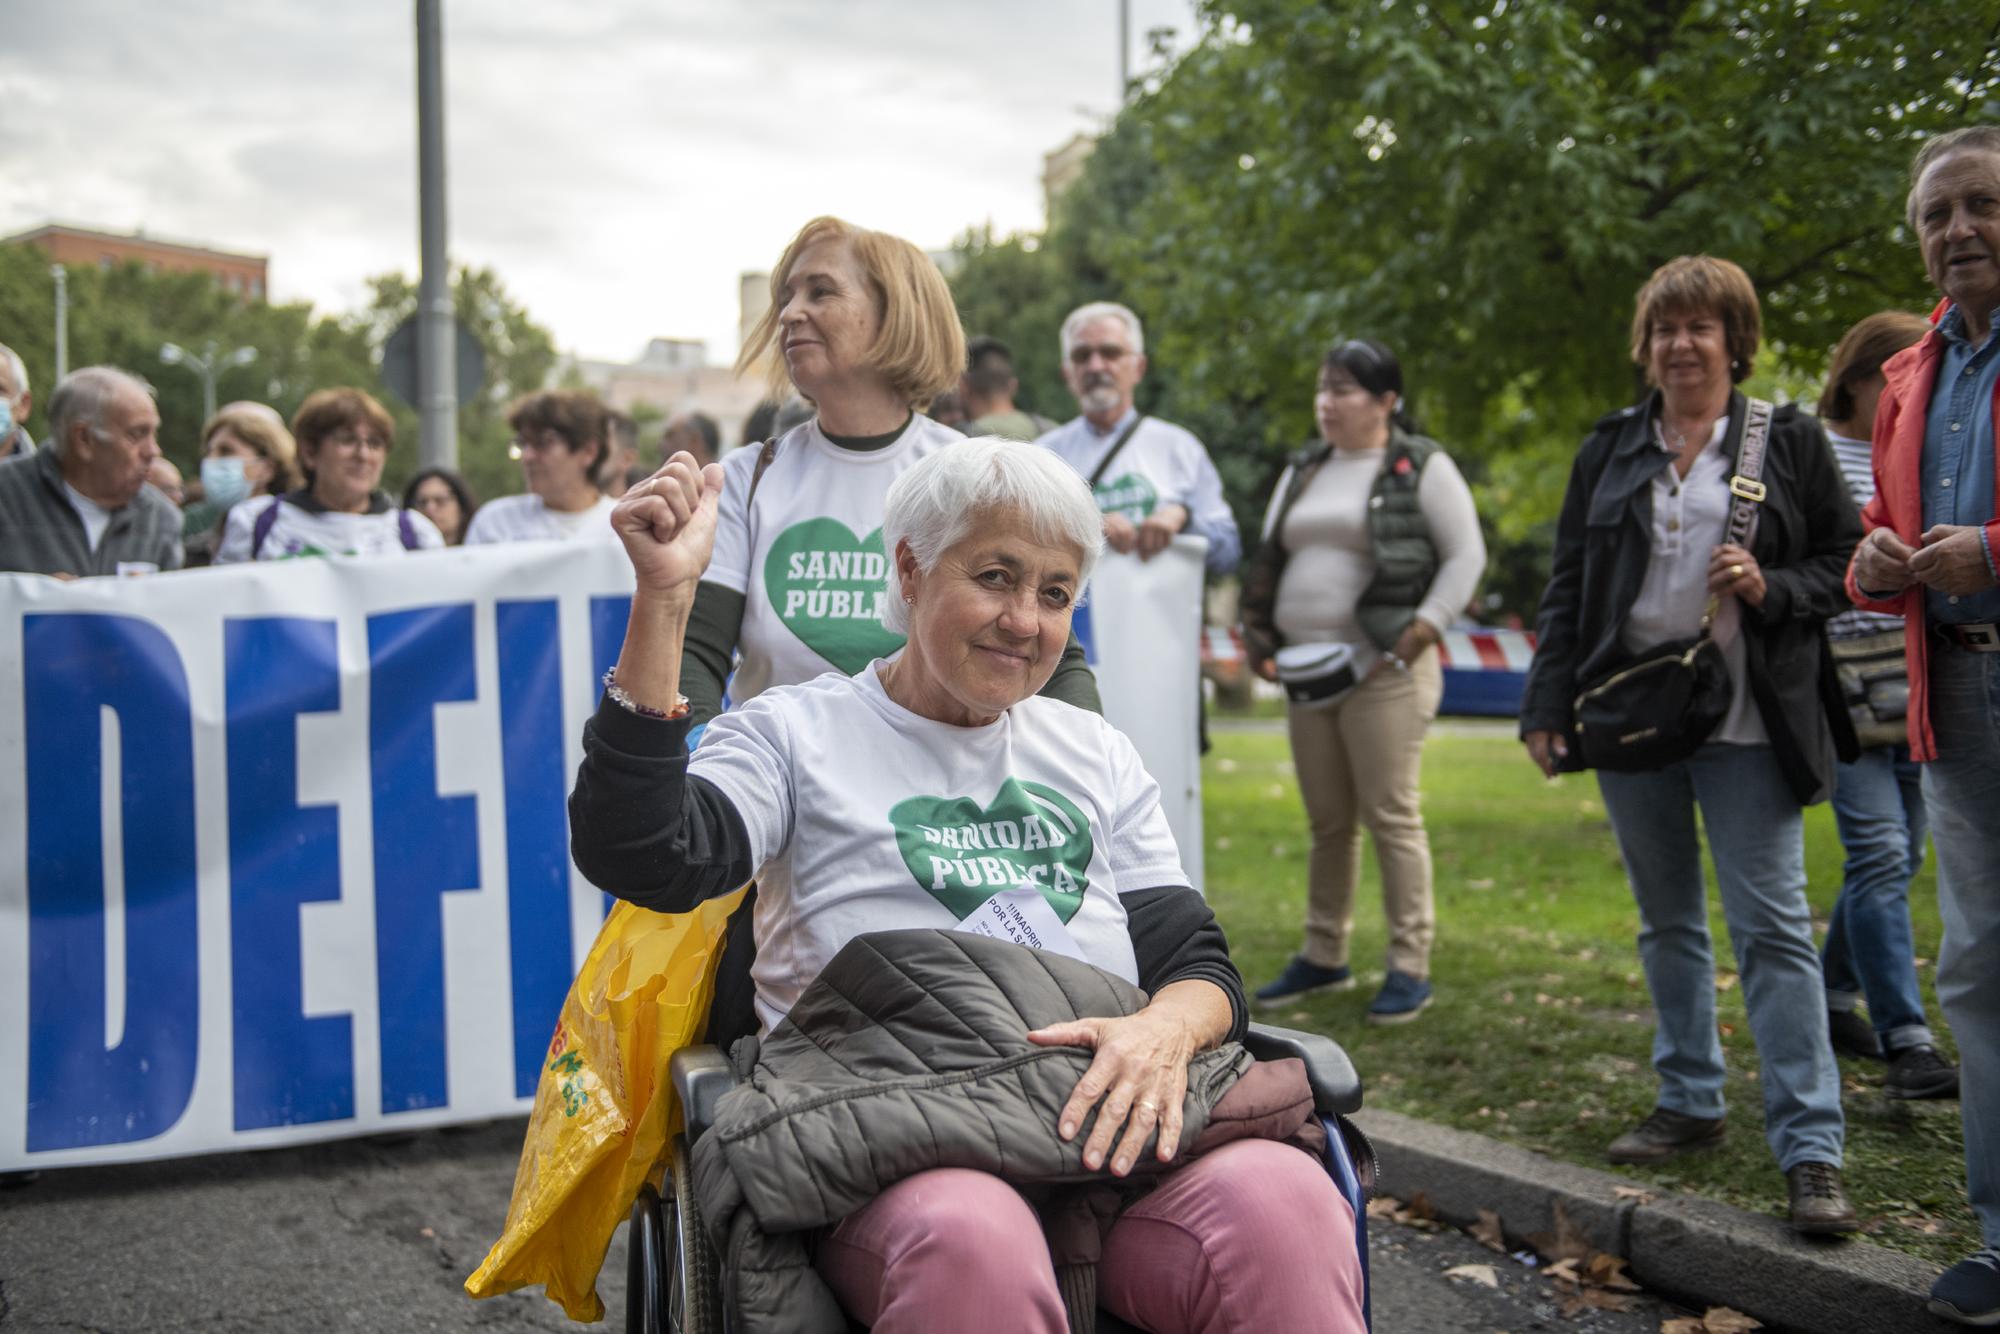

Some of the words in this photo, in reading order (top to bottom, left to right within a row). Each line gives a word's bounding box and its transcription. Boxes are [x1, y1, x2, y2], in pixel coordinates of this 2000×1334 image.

[916, 814, 1066, 851] SANIDAD
[22, 596, 633, 1153] DEFI
[988, 898, 1007, 921] POR
[1003, 920, 1016, 936] LA
[1006, 903, 1042, 949] !!!MADRID
